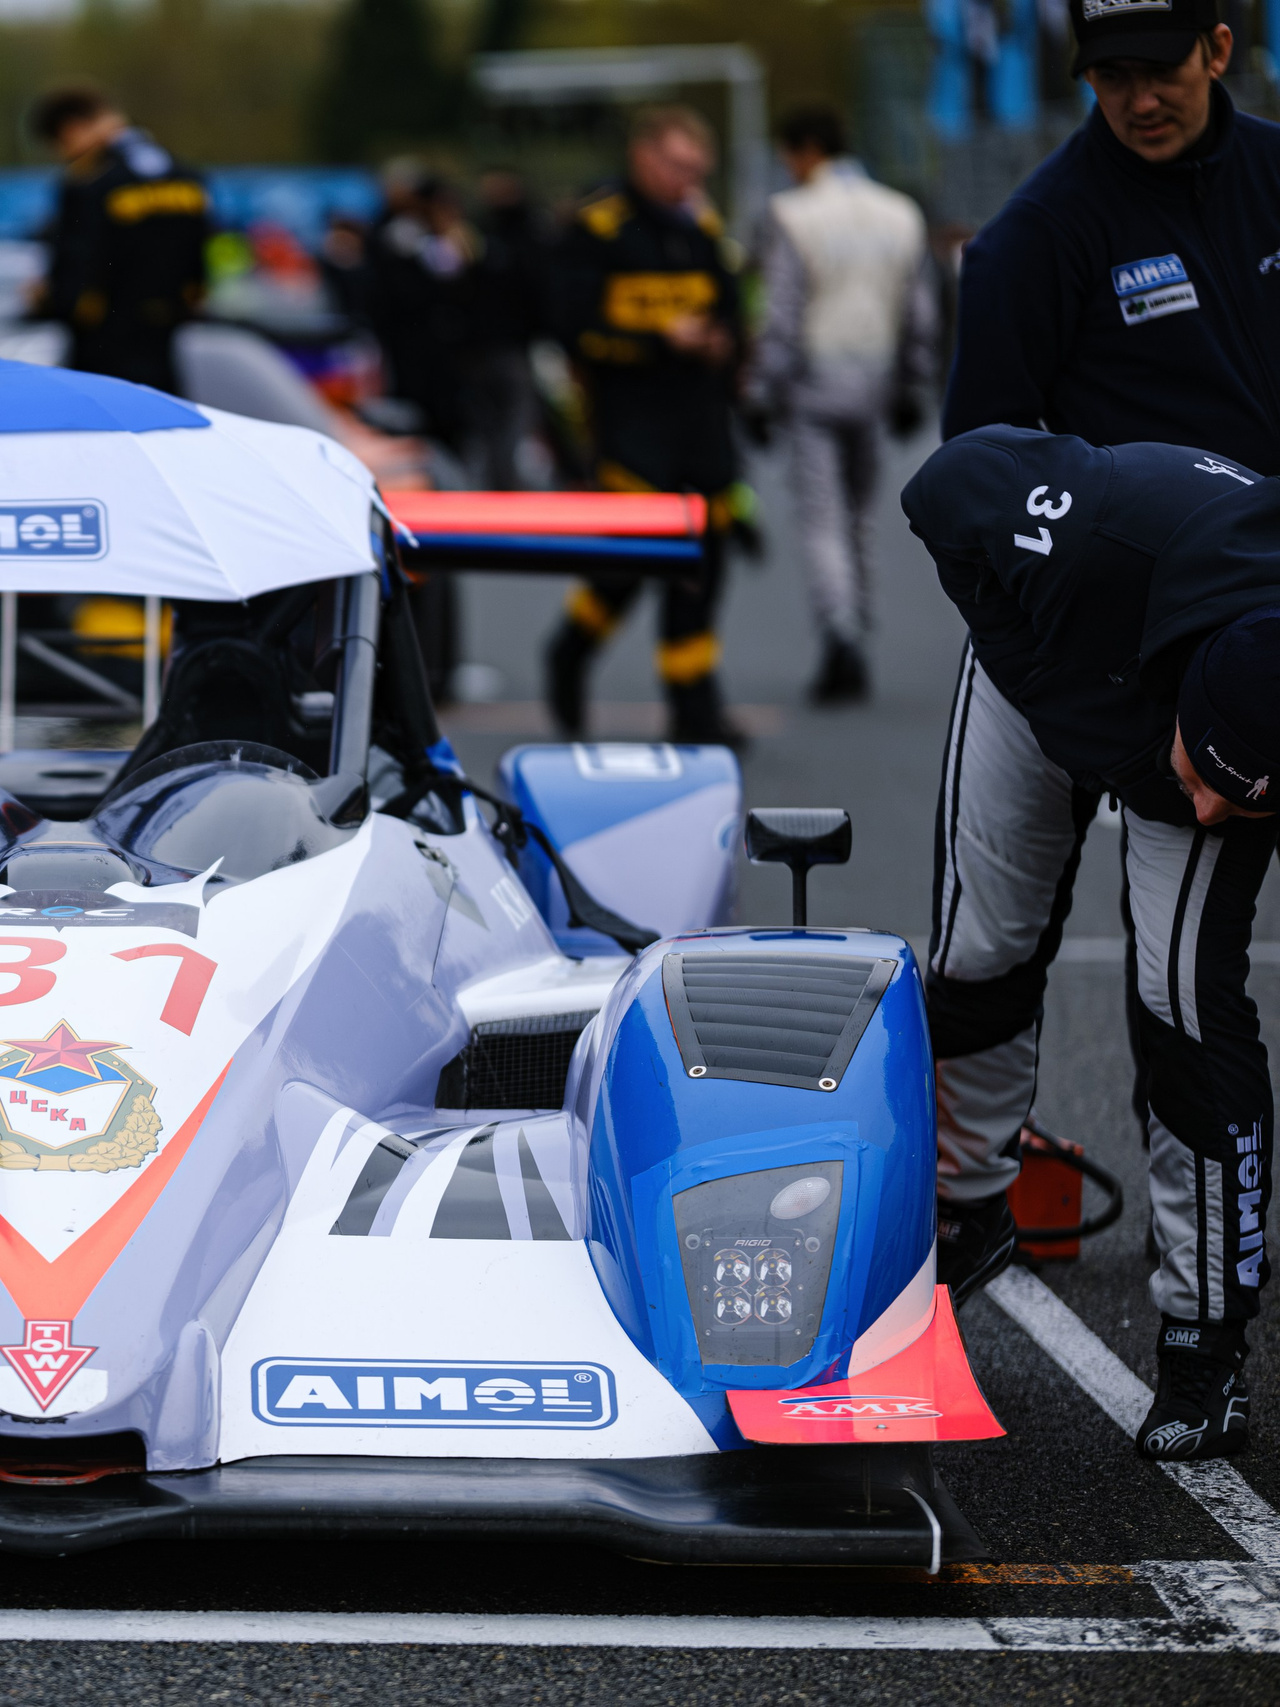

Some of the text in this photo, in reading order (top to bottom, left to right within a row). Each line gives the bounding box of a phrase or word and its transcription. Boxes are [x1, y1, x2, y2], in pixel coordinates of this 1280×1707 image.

[1014, 485, 1072, 556] 31
[10, 1090, 87, 1132] ЦСКА
[733, 1239, 772, 1247] RIGID
[937, 1220, 961, 1236] MP
[23, 1326, 70, 1370] TOW
[1165, 1329, 1201, 1344] OMP
[275, 1375, 593, 1413] AIMOL
